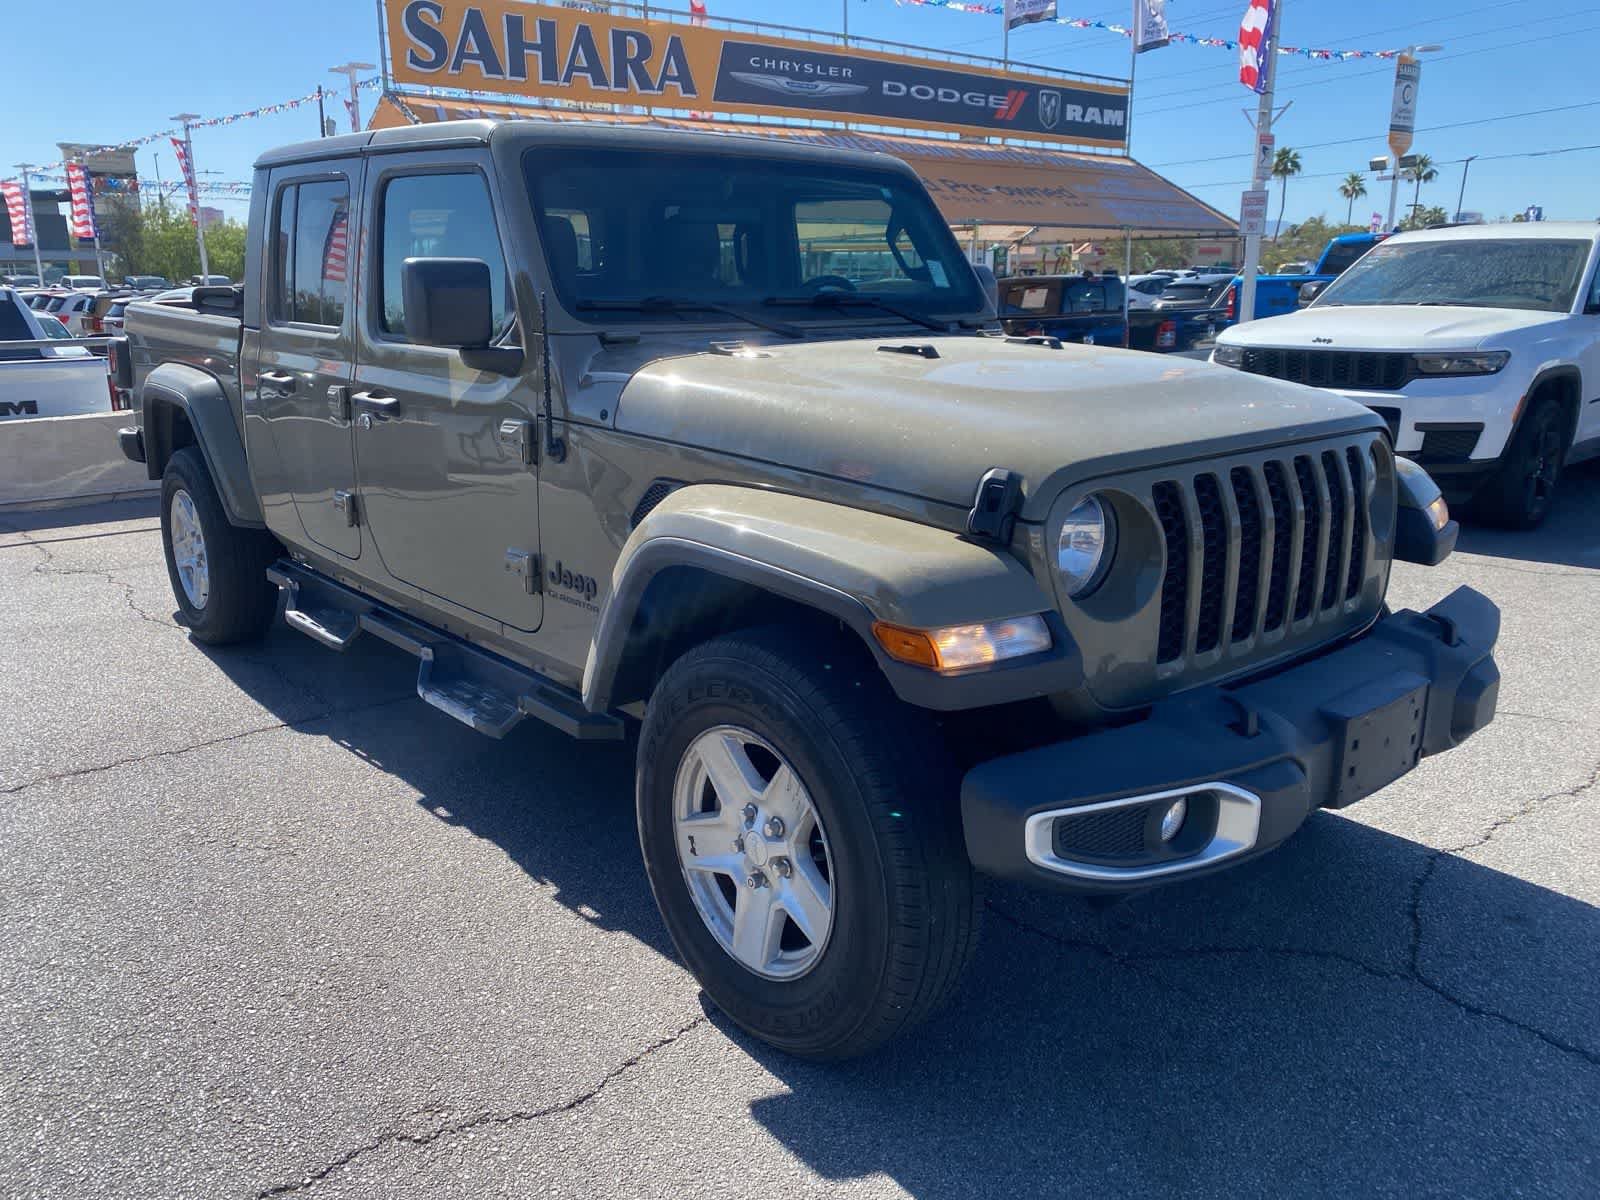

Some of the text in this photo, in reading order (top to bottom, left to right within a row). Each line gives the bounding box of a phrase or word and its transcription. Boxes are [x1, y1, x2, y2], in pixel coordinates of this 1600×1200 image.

[403, 0, 698, 98] SAHARA
[750, 57, 854, 79] CHRYSLER
[882, 80, 1012, 109] DODGE
[1066, 103, 1125, 127] RAM
[1311, 337, 1334, 345] Jeep
[548, 558, 597, 602] Jeep
